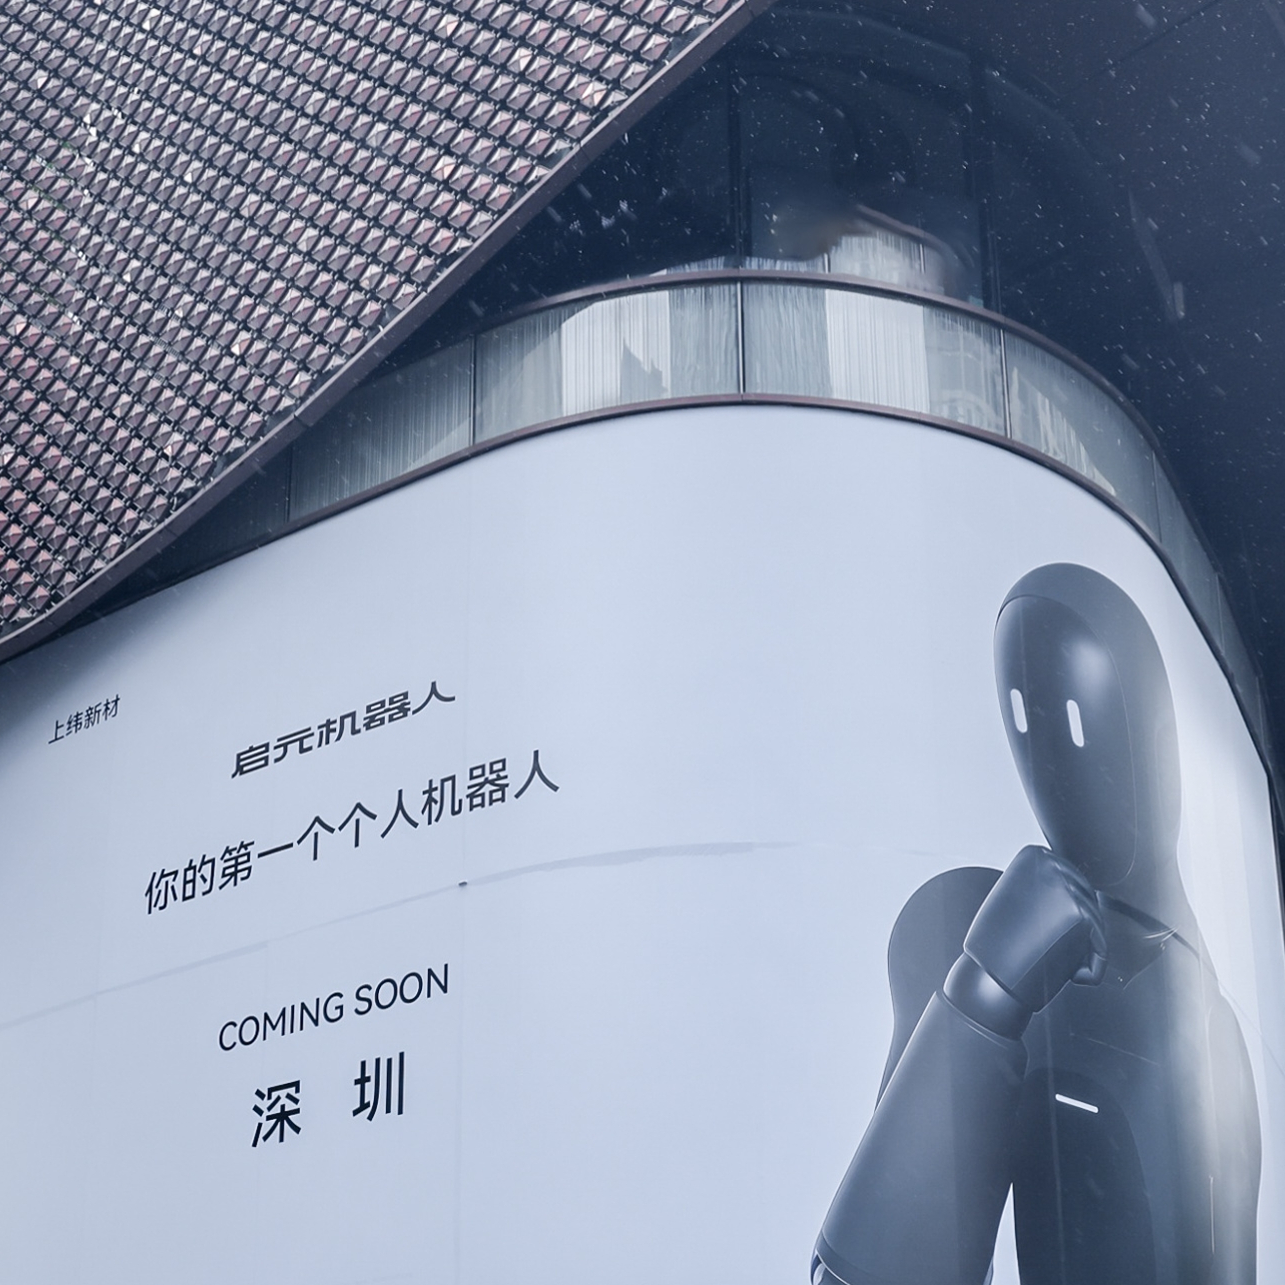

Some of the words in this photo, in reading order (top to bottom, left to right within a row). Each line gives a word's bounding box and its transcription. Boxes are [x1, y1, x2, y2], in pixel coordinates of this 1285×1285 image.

[47, 693, 121, 745] 上纬新材
[230, 680, 456, 780] 启元机器人
[144, 749, 560, 915] 你的第一个个人机器人
[218, 991, 344, 1052] COMING
[353, 962, 450, 1016] SOON
[251, 1050, 405, 1148] 深圳
